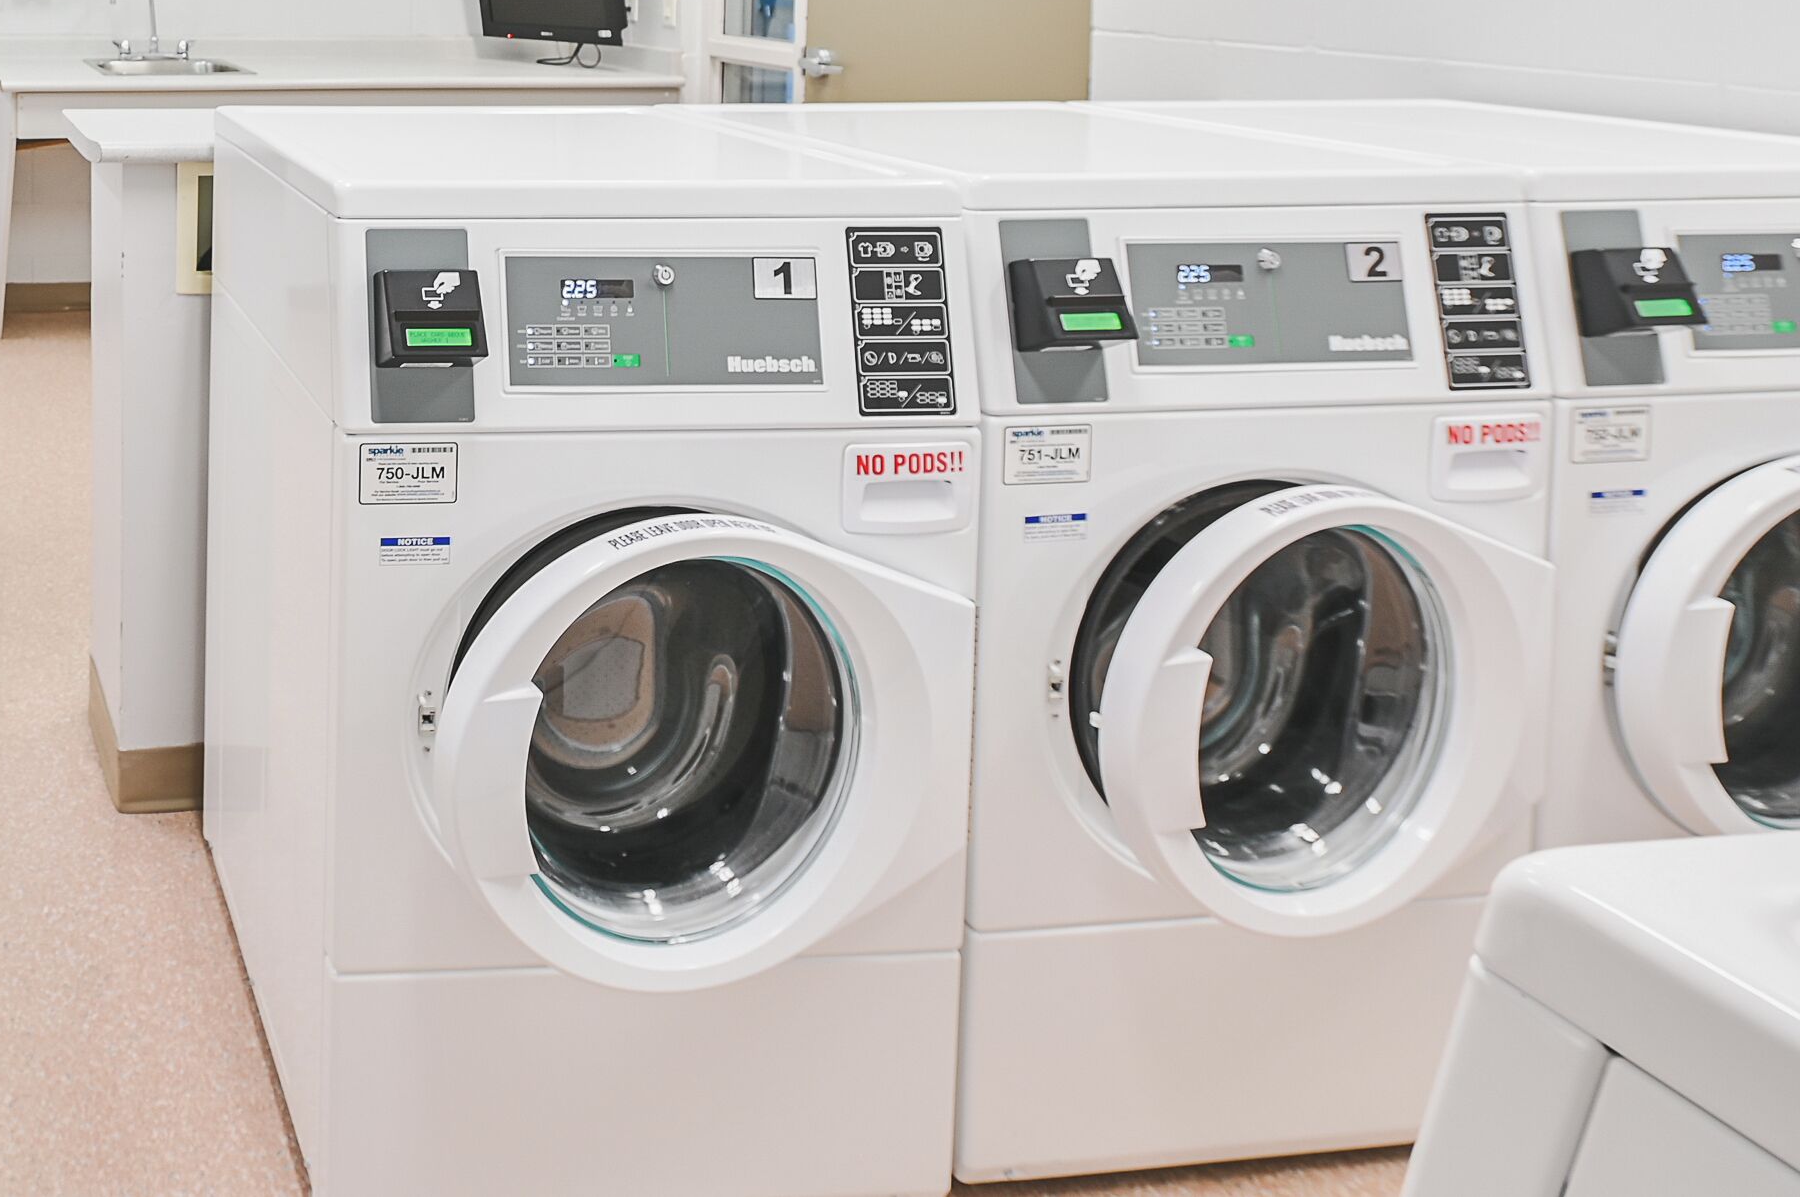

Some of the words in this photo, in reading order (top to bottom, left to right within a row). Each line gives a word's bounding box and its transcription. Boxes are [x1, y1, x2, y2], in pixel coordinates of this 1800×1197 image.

[1364, 246, 1388, 278] 2
[773, 261, 792, 296] 1
[1328, 334, 1410, 352] Huebsch
[727, 355, 818, 374] Huebsch
[1448, 425, 1474, 445] NO
[856, 454, 886, 476] NO
[894, 451, 964, 475] PODS!!
[1019, 446, 1080, 462] 751-JLM
[376, 466, 445, 480] 750-JLM
[398, 538, 434, 546] NOTICE
[608, 530, 648, 550] PLEASE
[642, 522, 680, 538] LEAVE
